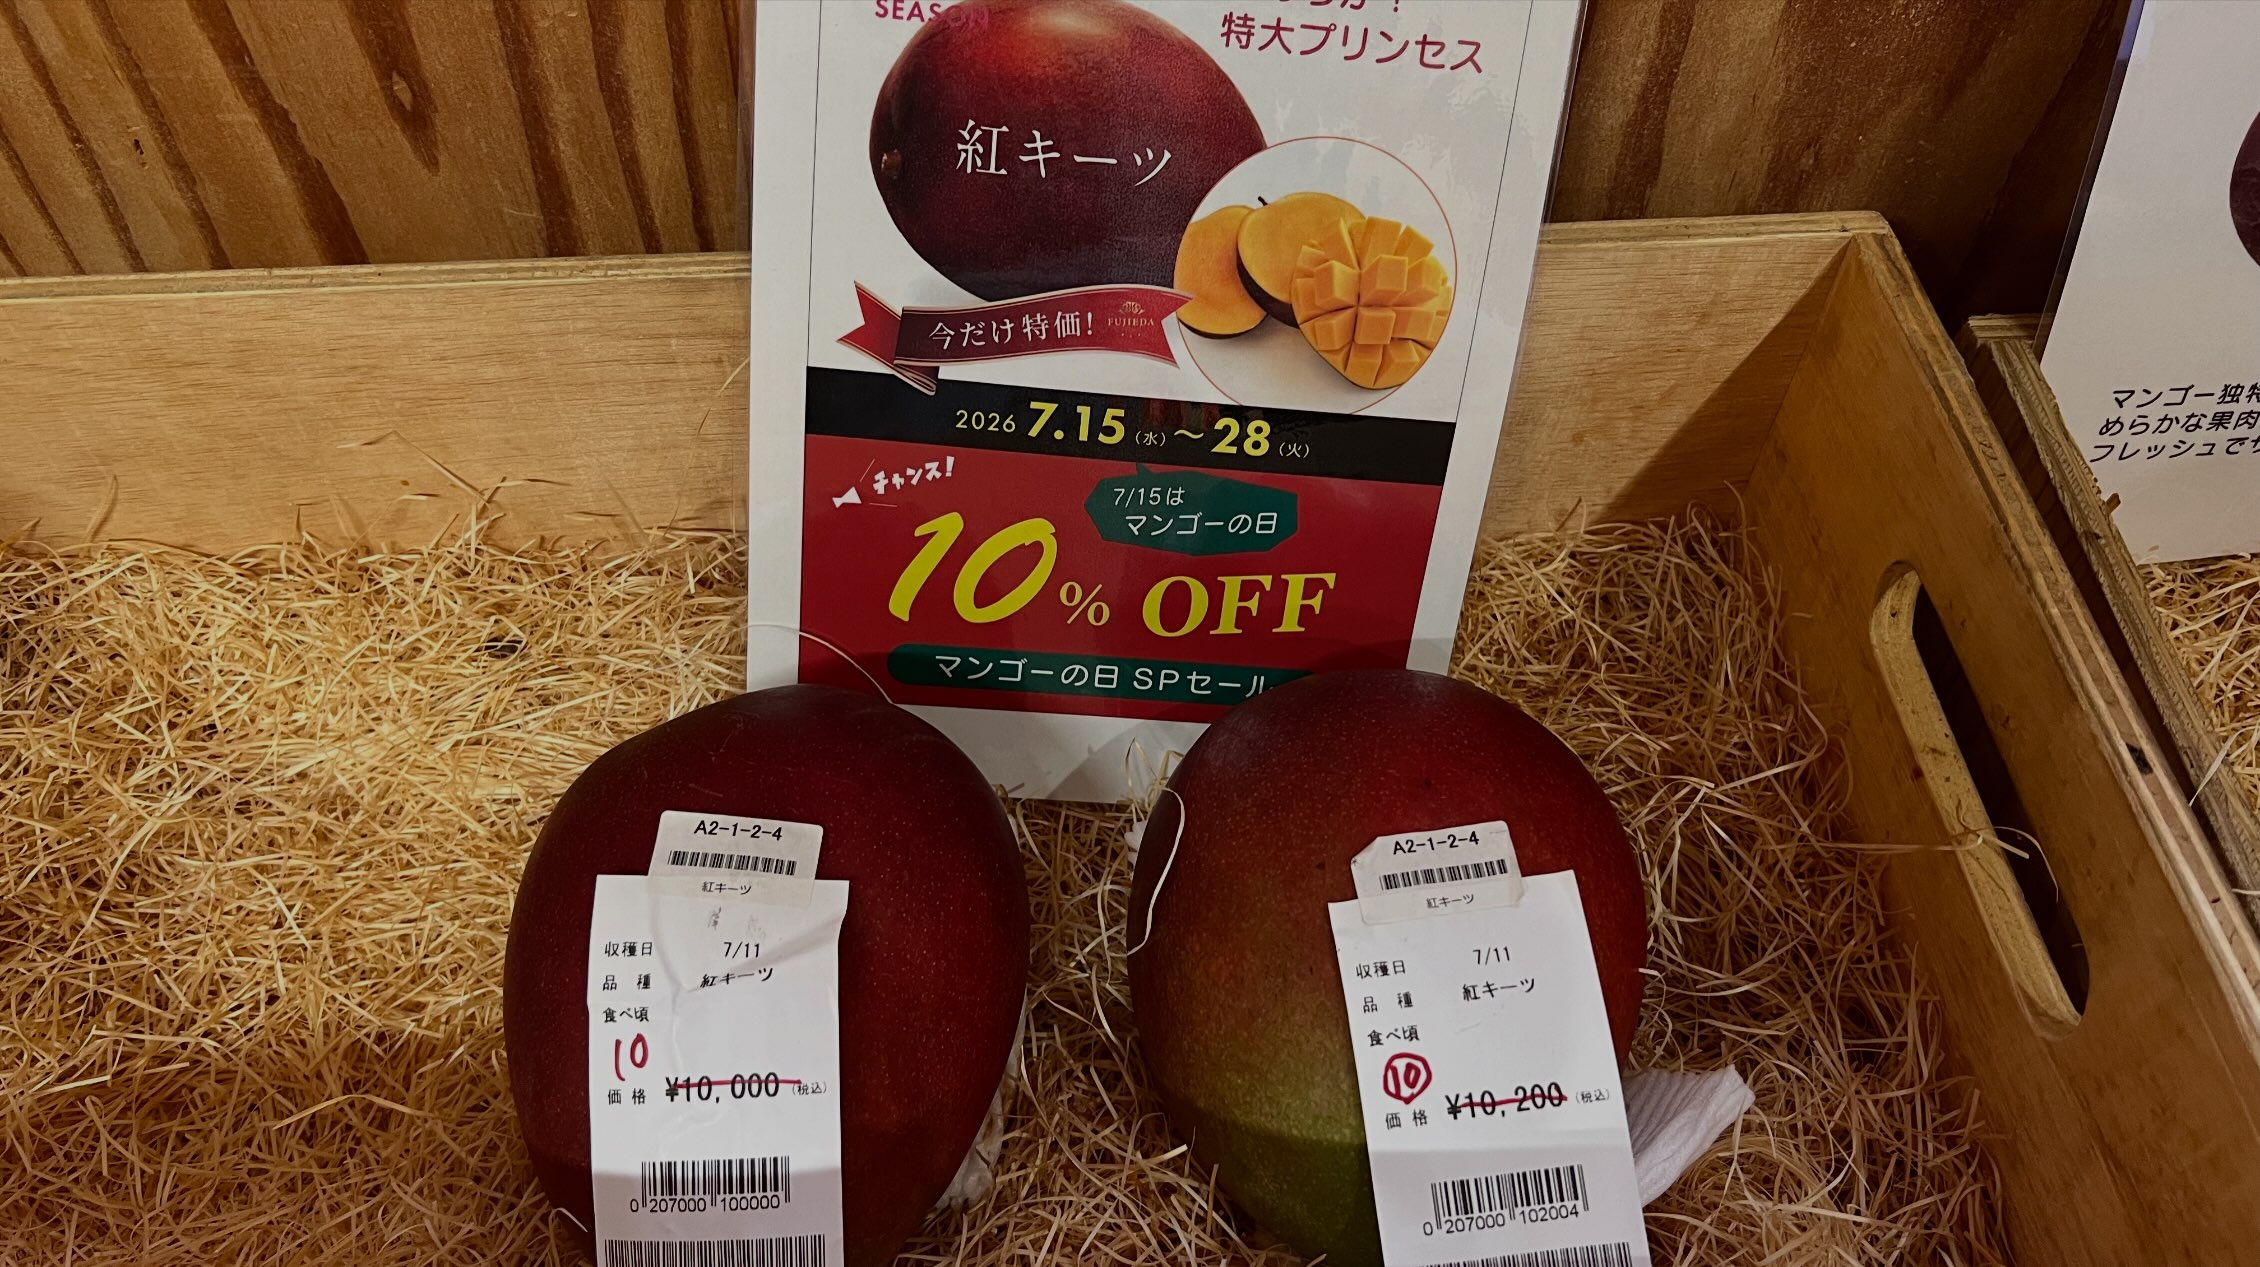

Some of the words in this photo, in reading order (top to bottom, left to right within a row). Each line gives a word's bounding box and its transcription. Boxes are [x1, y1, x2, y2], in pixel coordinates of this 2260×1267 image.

[875, 0, 991, 29] SEASON
[1221, 12, 1482, 73] 特大プリンセス
[955, 119, 1174, 187] 紅キーツ
[929, 311, 1093, 350] 今だけ特価!
[1107, 317, 1154, 328] FUJIEDA
[955, 410, 1016, 432] 2026
[2099, 410, 2260, 436] めらかな果肉
[872, 455, 955, 494] チャンス!
[1113, 486, 1185, 506] 7/15は
[1125, 511, 1277, 536] マンゴーの日
[1142, 572, 1336, 638] OFF
[935, 654, 1119, 689] マンゴーの日
[694, 820, 783, 841] A2-1-2-4
[1393, 831, 1480, 855] A2-1-2-4
[701, 880, 752, 895] 紅キーツ
[1426, 893, 1475, 909] 紅キーツ
[604, 941, 653, 957] 収穫日
[723, 942, 760, 959] 7/11
[1356, 960, 1407, 979] 収穫日
[1472, 946, 1512, 966] 7/11
[700, 967, 773, 988] 紅キーツ
[1462, 977, 1536, 1002] 紅キーツ
[603, 1007, 650, 1023] 食べ頃
[1368, 1025, 1420, 1046] 食べ頃
[614, 1033, 649, 1081] 10
[665, 1072, 780, 1104] ¥10,000
[791, 1081, 828, 1096] (税込)
[1445, 1082, 1564, 1120] ¥10,200
[1575, 1088, 1610, 1104] (税込)
[630, 1199, 640, 1213] 0
[649, 1198, 707, 1213] 207000
[720, 1195, 781, 1210] 100000
[1422, 1221, 1433, 1236] 0
[1445, 1212, 1506, 1234] 207000
[1521, 1203, 1579, 1224] 102004
